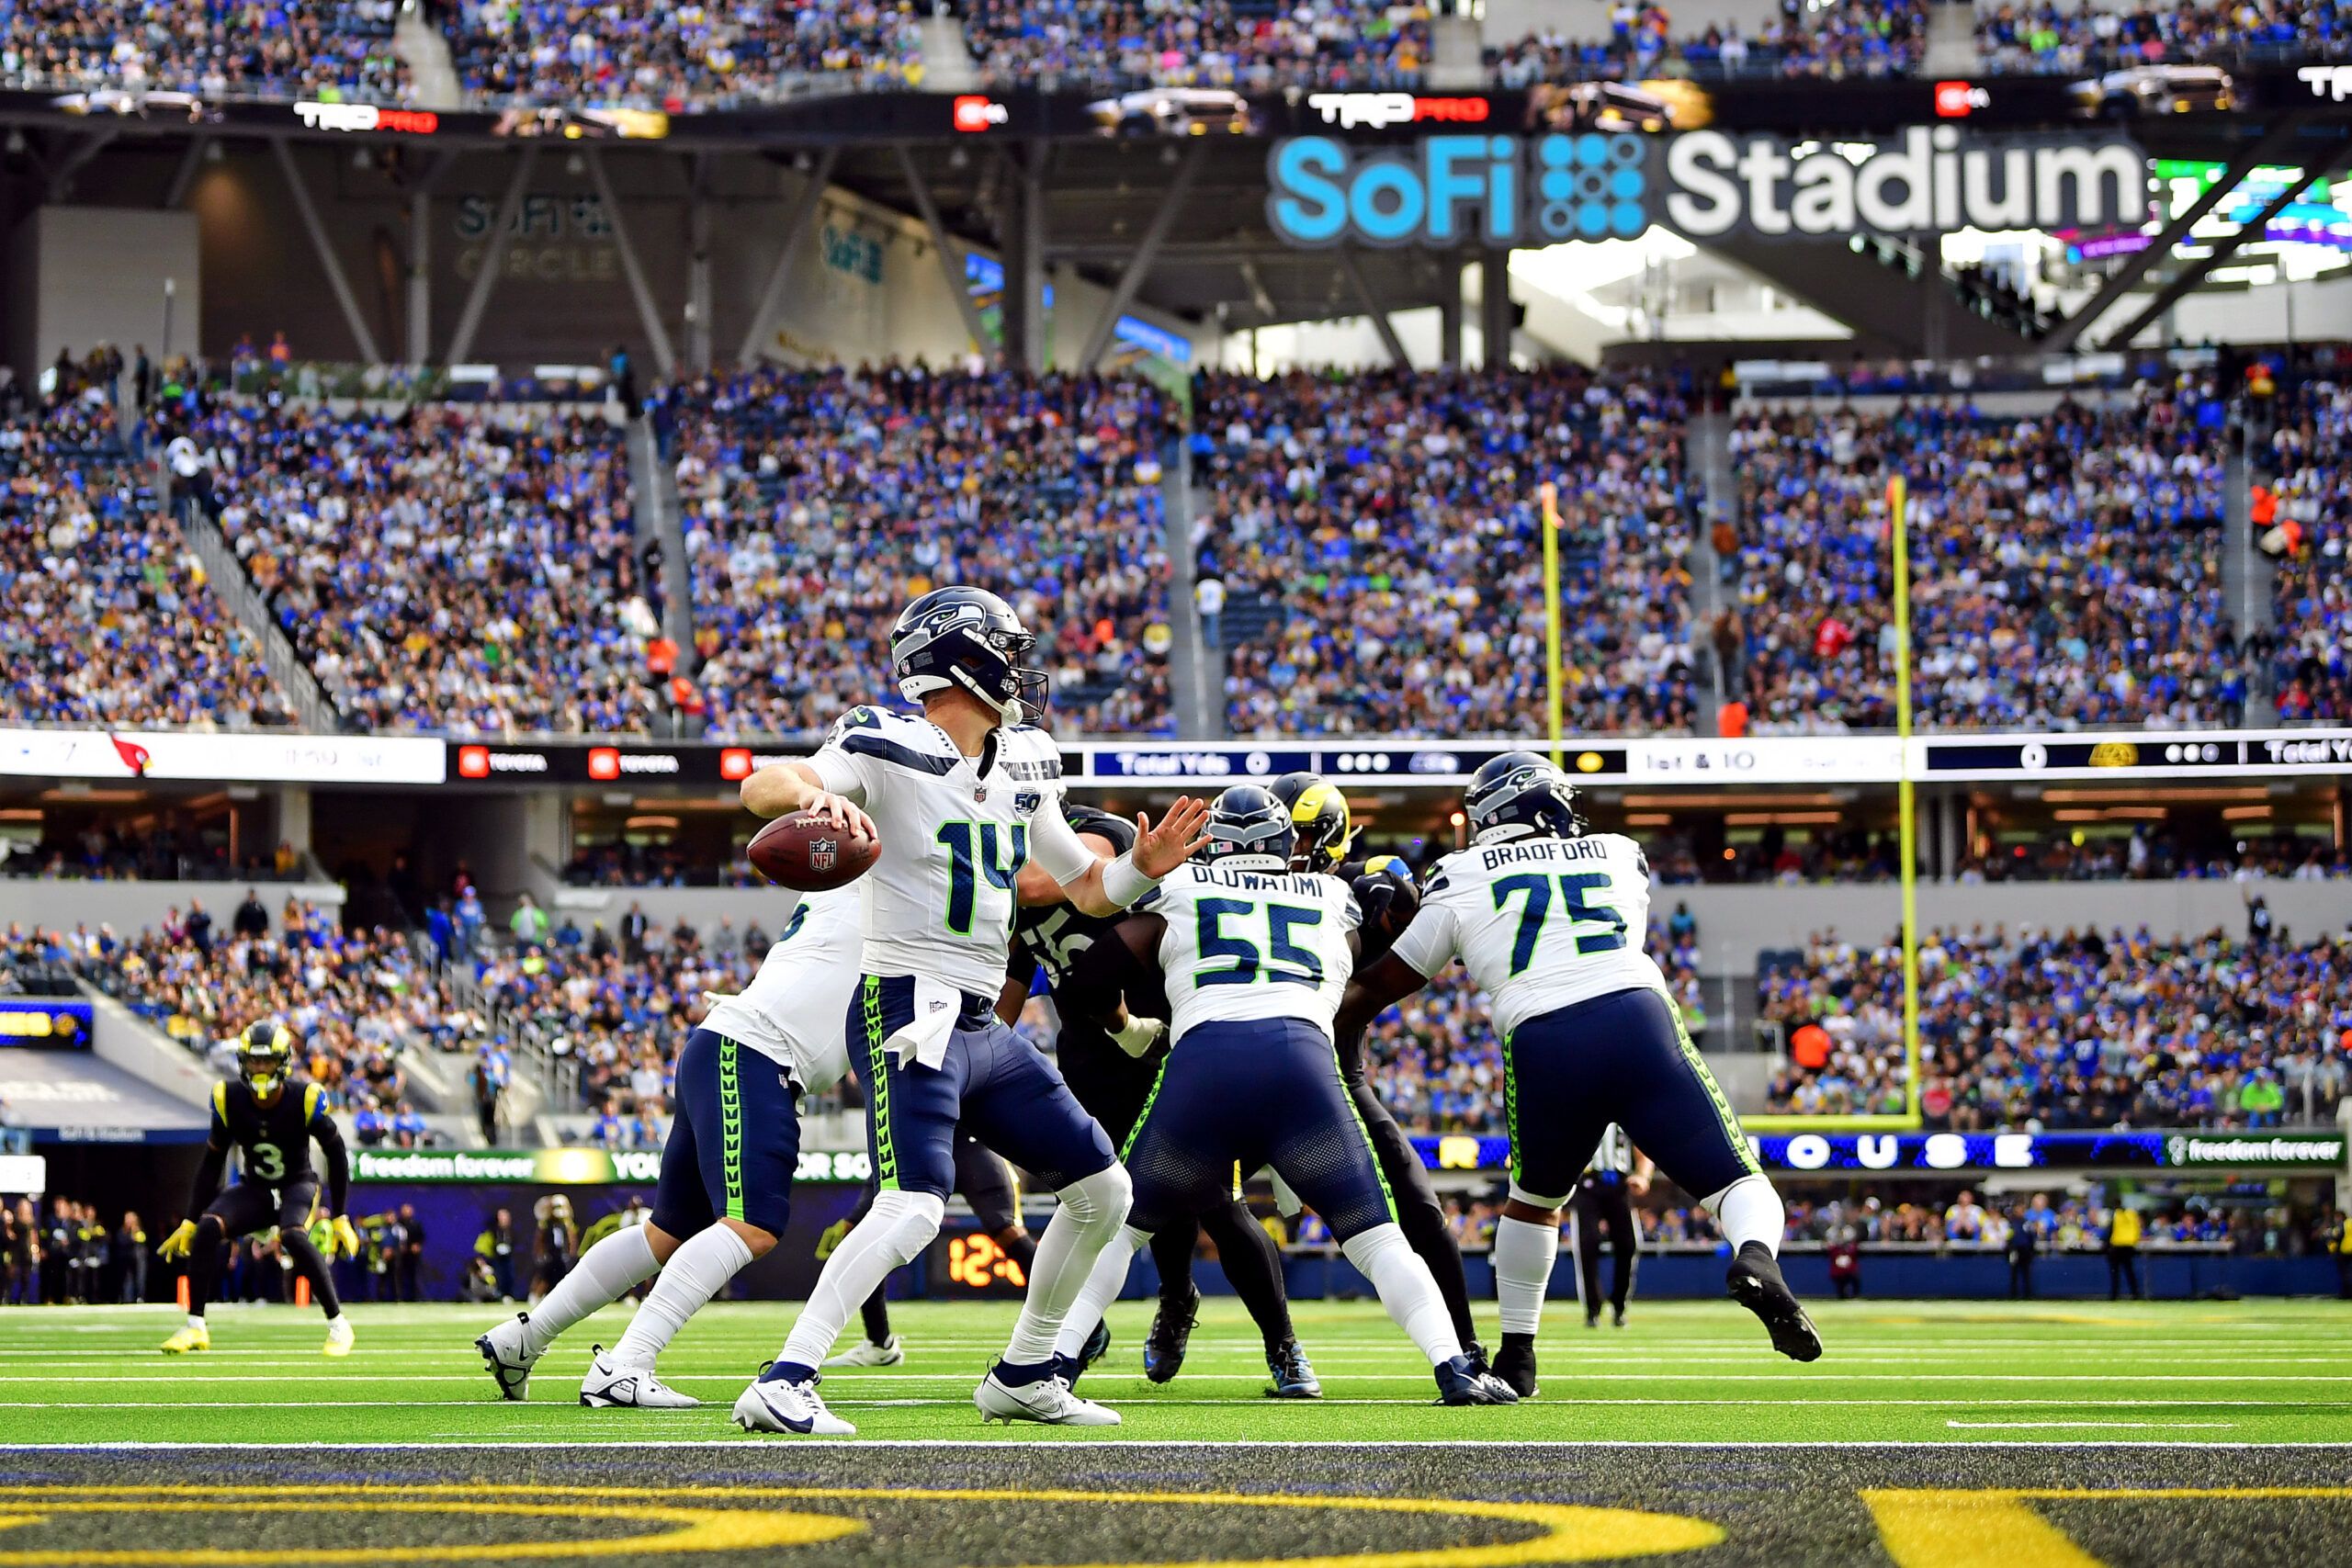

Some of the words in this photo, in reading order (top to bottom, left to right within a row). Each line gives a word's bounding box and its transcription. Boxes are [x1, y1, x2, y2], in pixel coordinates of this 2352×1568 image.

[1276, 135, 1515, 241] SoFi
[1667, 125, 2143, 235] Stadium
[1115, 751, 1181, 775] Total
[1180, 751, 1231, 775] Yds
[1245, 750, 1272, 776] 0
[1695, 752, 1711, 770] &
[1724, 750, 1756, 771] 10
[2021, 743, 2048, 770] 0
[2264, 739, 2331, 763] Total
[1014, 793, 1042, 814] 50
[813, 853, 833, 870] NFL
[1483, 840, 1608, 871] BRADFORD
[934, 819, 1030, 937] 14
[1490, 872, 1628, 979] 75
[1193, 897, 1326, 992] 55
[253, 1143, 286, 1180] 3
[2188, 1138, 2270, 1161] freedom
[2270, 1137, 2343, 1161] forever
[358, 1153, 455, 1178] freedom
[454, 1153, 535, 1179] forever
